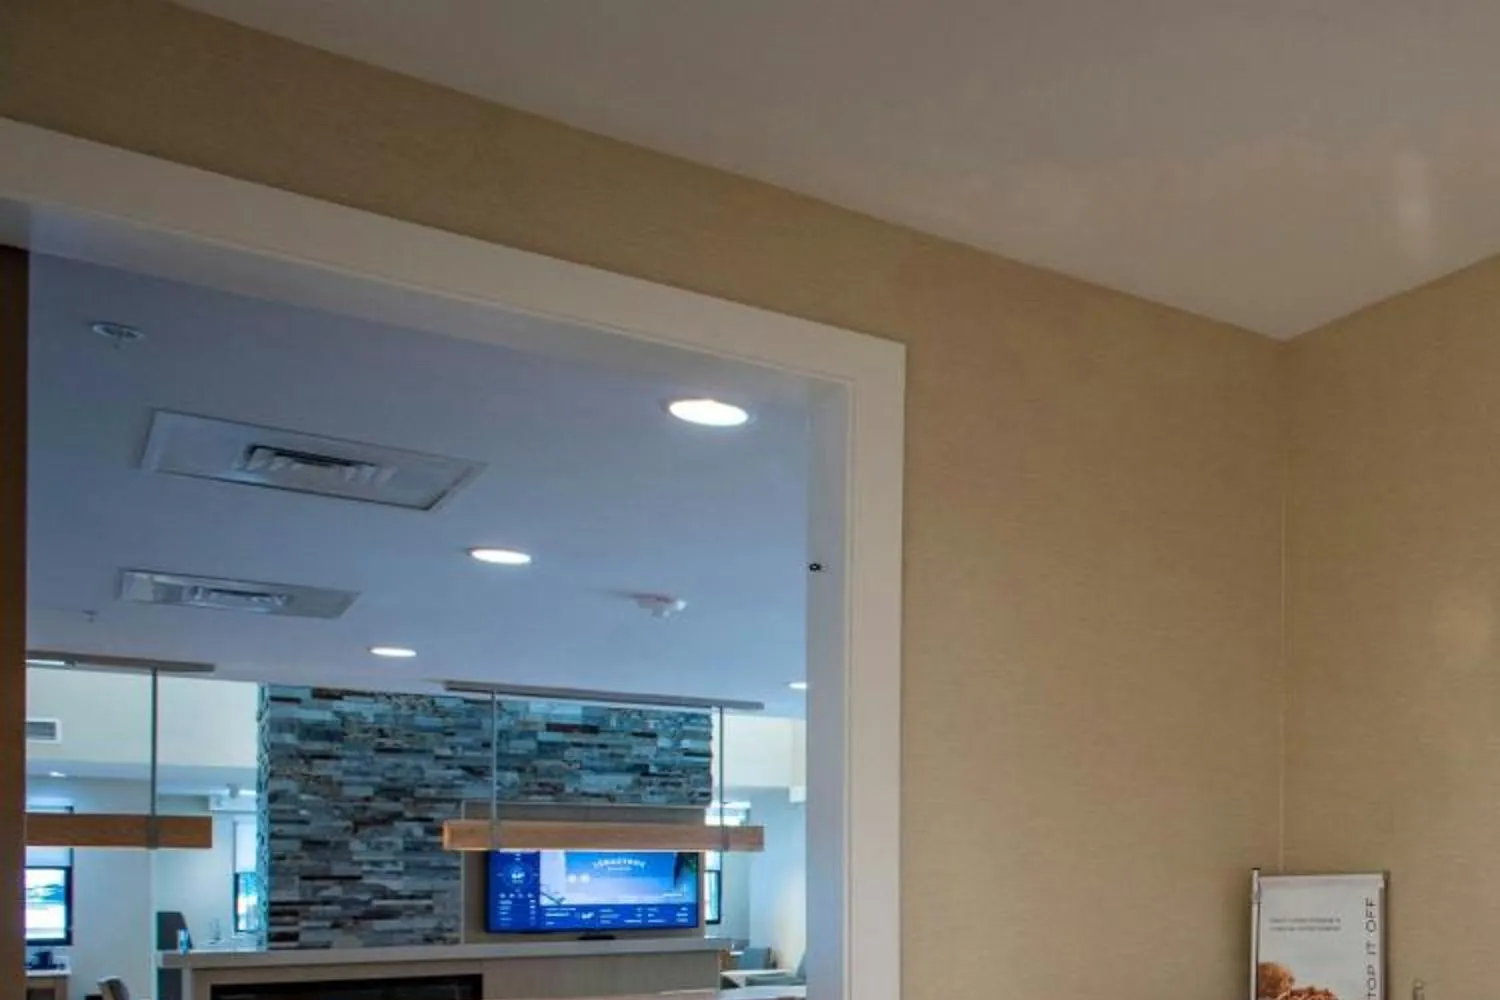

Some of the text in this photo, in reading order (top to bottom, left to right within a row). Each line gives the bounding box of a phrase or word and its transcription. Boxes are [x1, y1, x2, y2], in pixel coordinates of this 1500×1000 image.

[1365, 897, 1377, 1000] TOP IT OFF
